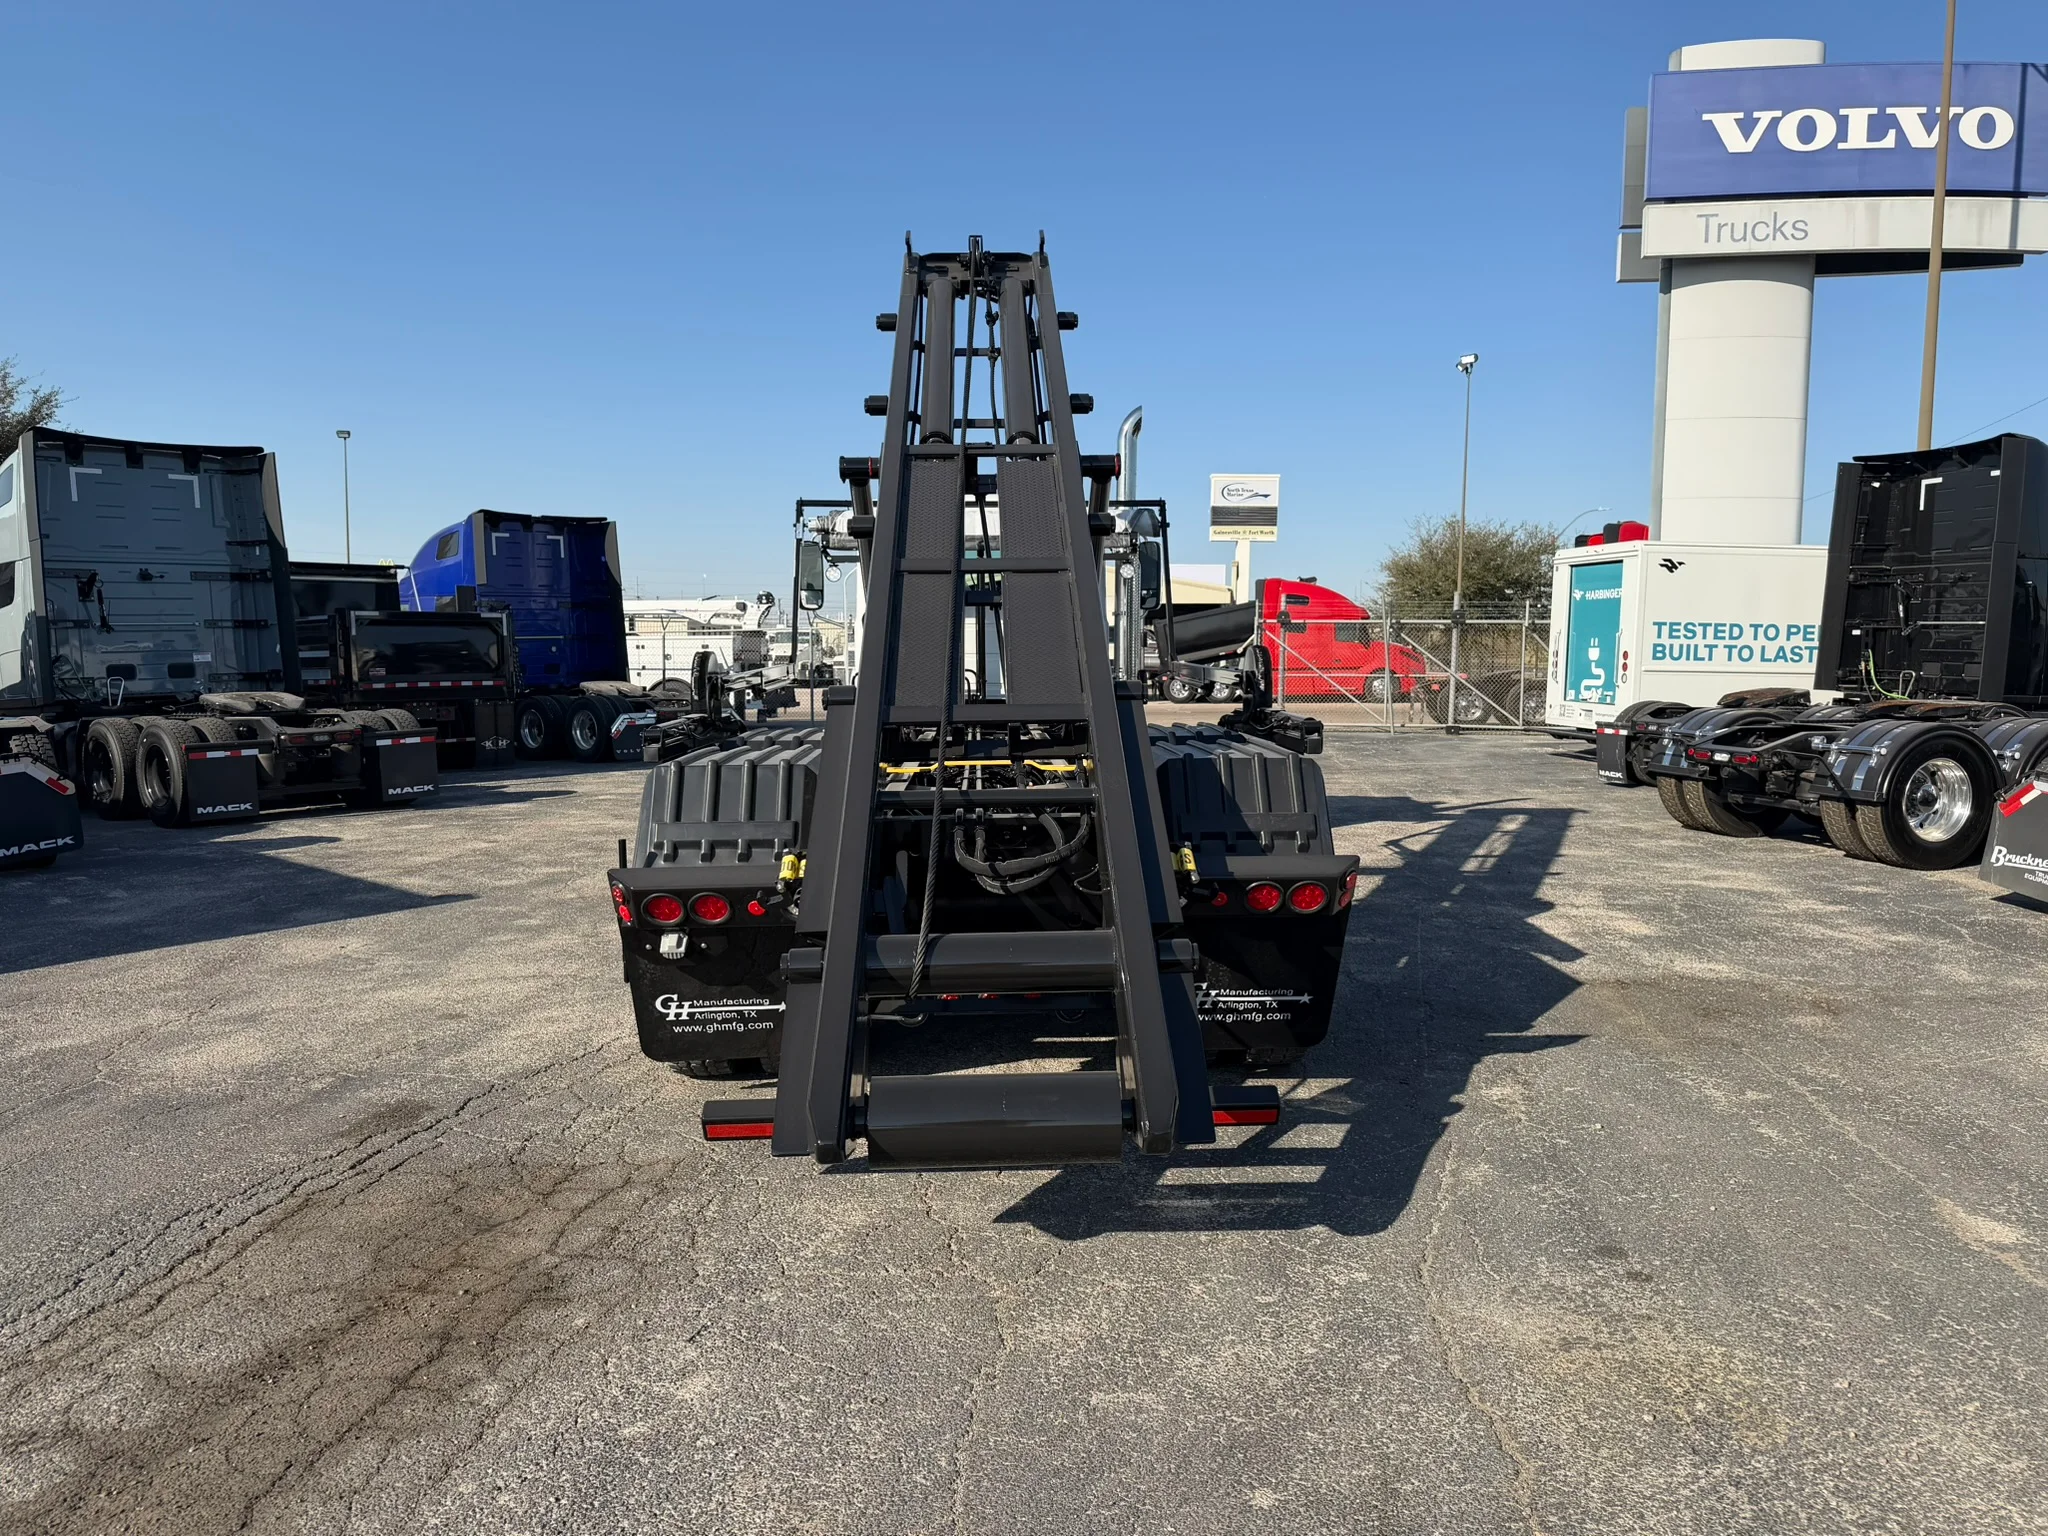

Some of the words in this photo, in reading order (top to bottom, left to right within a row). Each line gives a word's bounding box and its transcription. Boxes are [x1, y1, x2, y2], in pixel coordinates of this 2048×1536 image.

[1702, 106, 2014, 154] VOLVO
[1696, 211, 1809, 244] Trucks
[1652, 621, 1744, 640] TESTED
[1749, 623, 1780, 641] TO
[1786, 624, 1821, 642] PE
[1652, 643, 1719, 662] BUILT
[1723, 644, 1754, 662] TO
[1760, 645, 1820, 663] LAST
[1599, 769, 1624, 779] MACK
[388, 784, 435, 795] MACK
[197, 802, 253, 815] MACK
[0, 835, 75, 857] MACK
[2035, 870, 2048, 881] TRU
[1220, 988, 1294, 996] Manufacturing
[693, 998, 769, 1007] Manufacturing
[1217, 1001, 1262, 1010] Arlington,
[694, 1011, 741, 1020] Arlington,
[743, 1010, 757, 1018] TX
[673, 1021, 774, 1033] www.ghmfg.com
